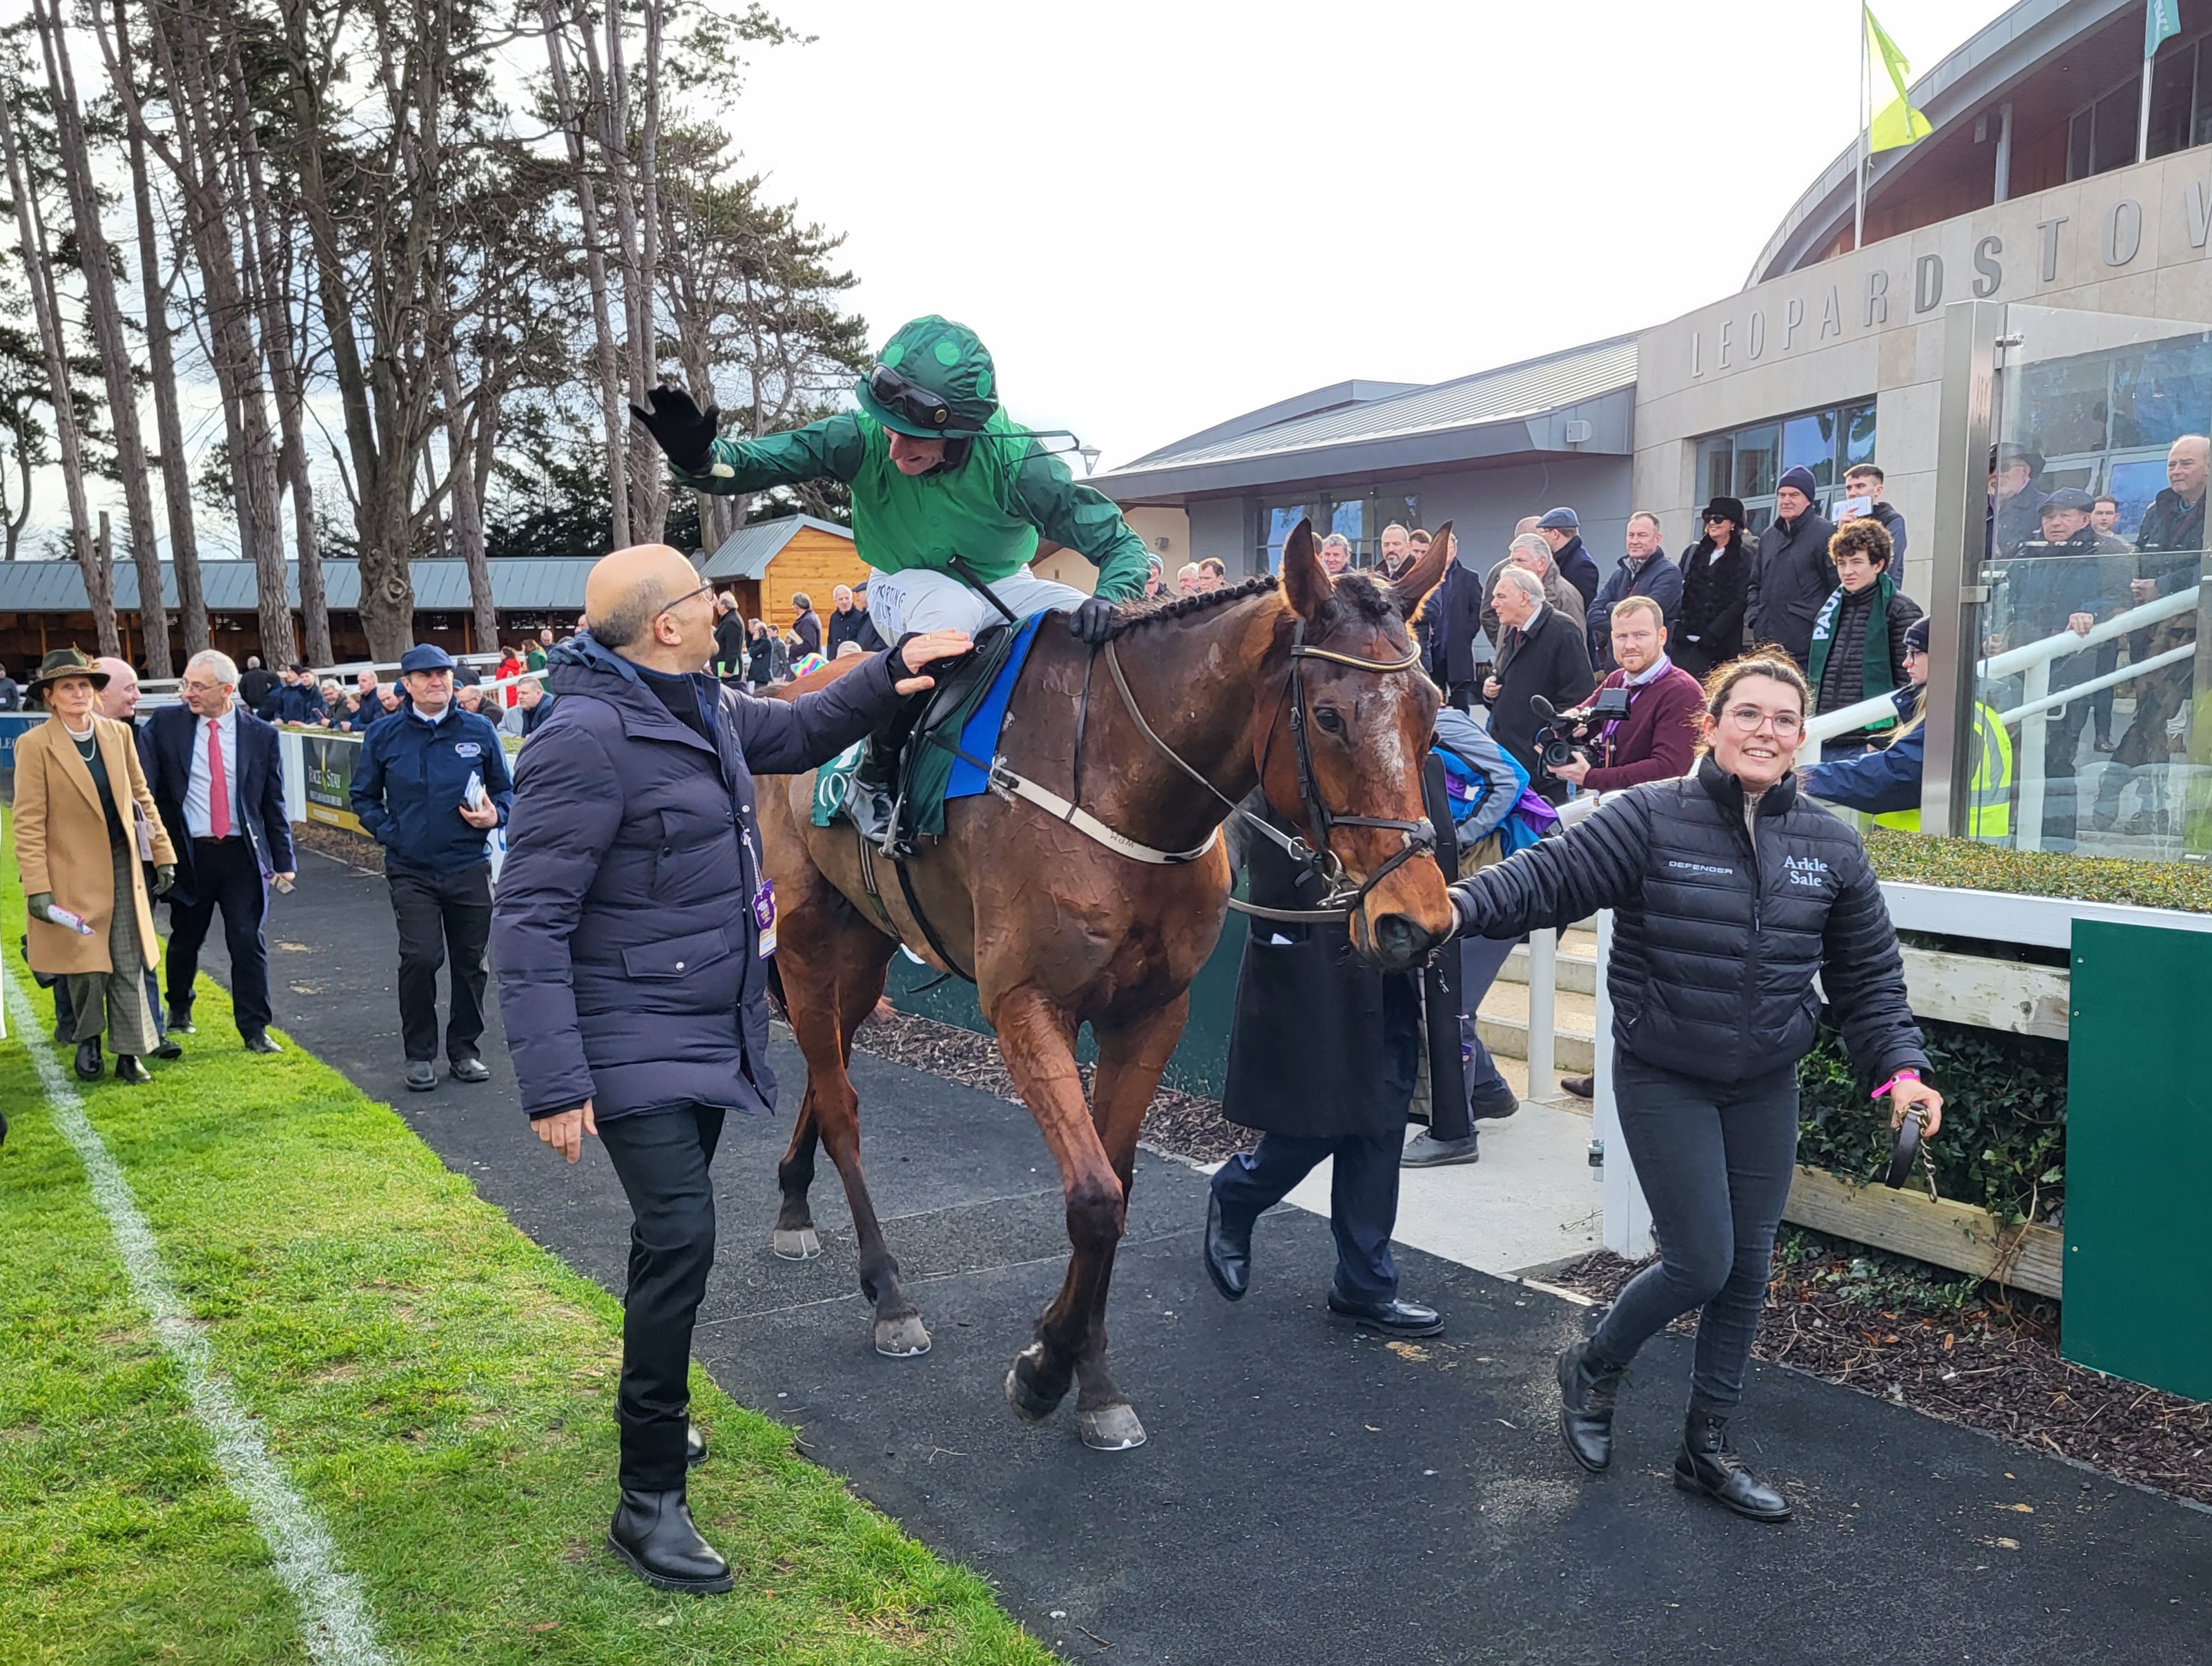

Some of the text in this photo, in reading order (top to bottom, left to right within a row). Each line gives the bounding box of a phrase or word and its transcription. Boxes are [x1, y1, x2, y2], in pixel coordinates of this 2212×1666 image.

[1110, 831, 1134, 849] WPM
[1668, 860, 1734, 875] DEFENDER
[1783, 855, 1828, 873] Arkle
[1789, 871, 1822, 887] Sale
